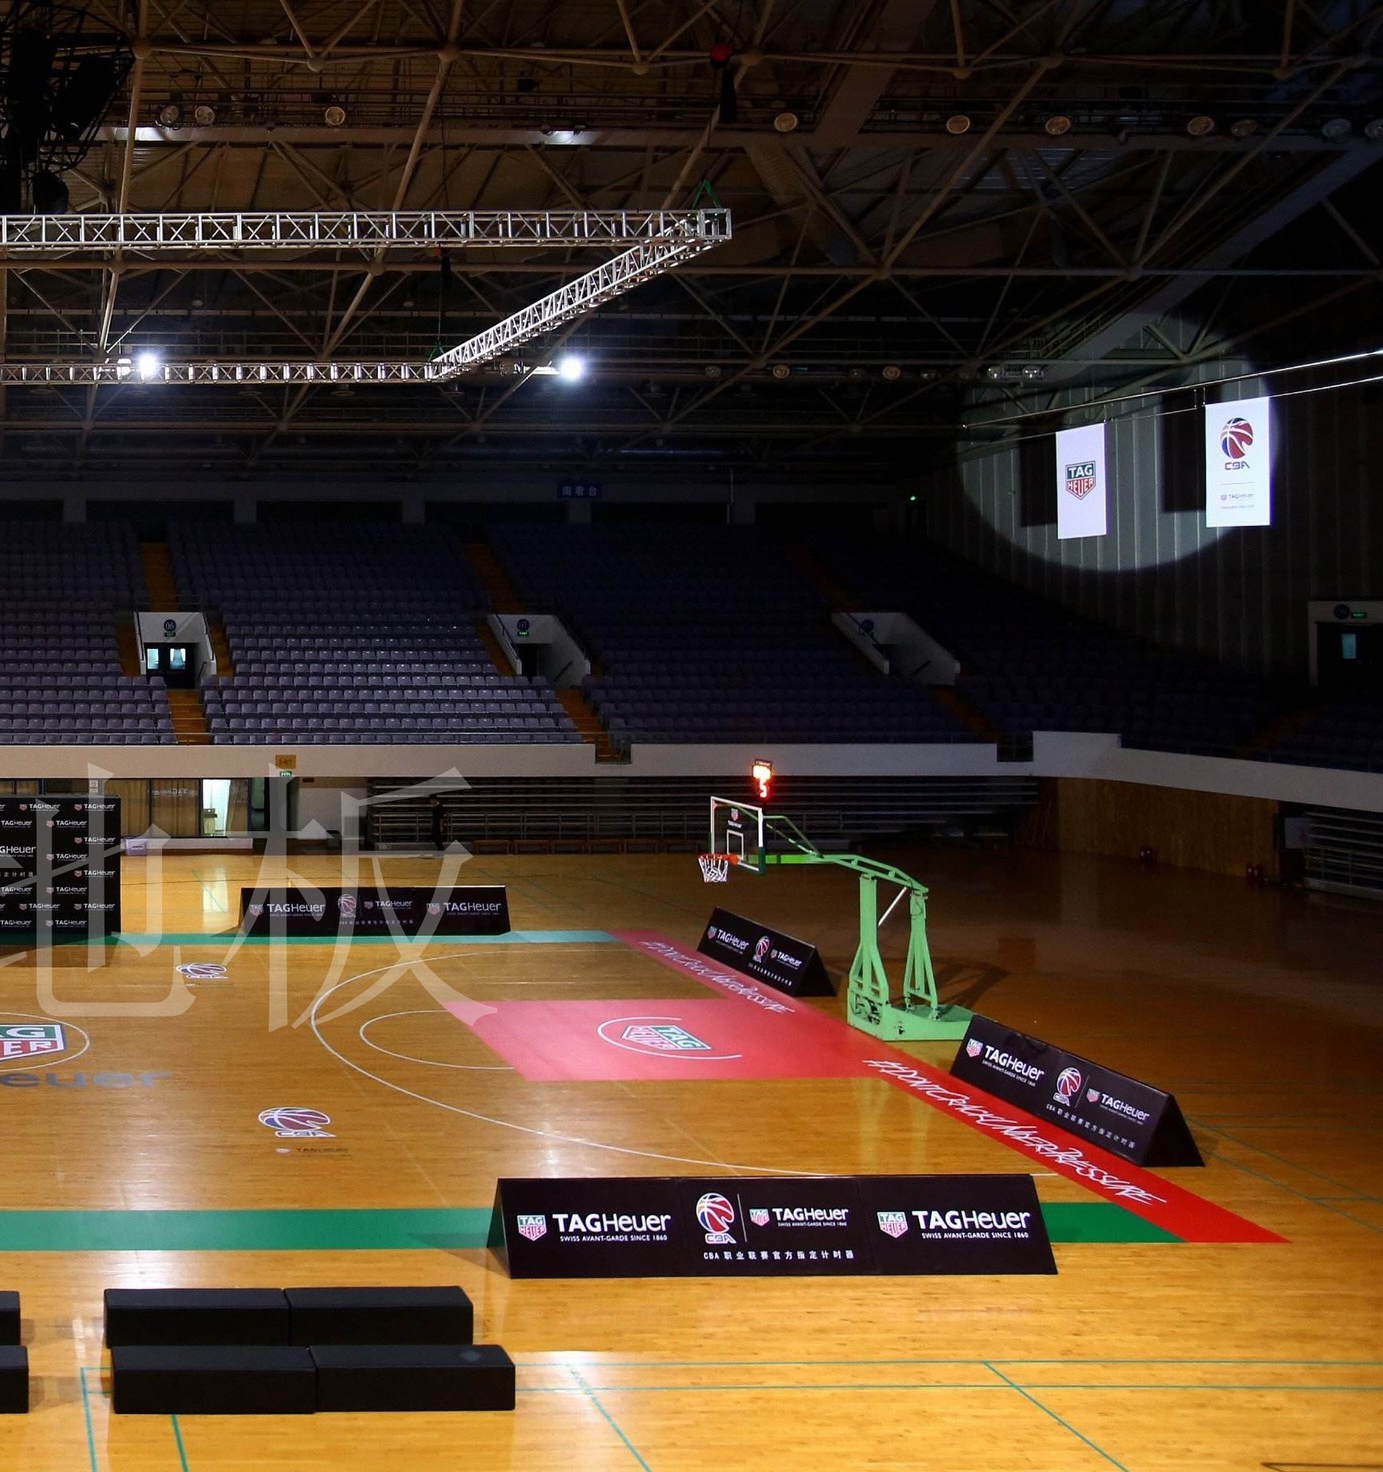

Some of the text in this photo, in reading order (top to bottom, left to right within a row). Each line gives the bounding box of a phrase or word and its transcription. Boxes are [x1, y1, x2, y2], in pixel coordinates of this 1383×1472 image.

[1068, 464, 1093, 477] TAG
[1067, 478, 1095, 496] HEUER
[165, 621, 175, 630] 06
[267, 903, 325, 913] TAGHeuer
[443, 902, 501, 911] TAGHeuer
[716, 928, 749, 950] TAGHeuer
[984, 1045, 1045, 1081] TAGHeuer
[1100, 1093, 1150, 1121] TAGHeuer
[519, 1216, 544, 1225] TAG
[772, 1208, 849, 1221] TAGHeuer
[880, 1213, 904, 1222] TAG
[912, 1210, 1030, 1229] TAGHeuer
[552, 1213, 671, 1232] TAGHeuer
[882, 1222, 906, 1236] HEUER
[520, 1225, 546, 1238] HEUER
[703, 1252, 719, 1260] CBA
